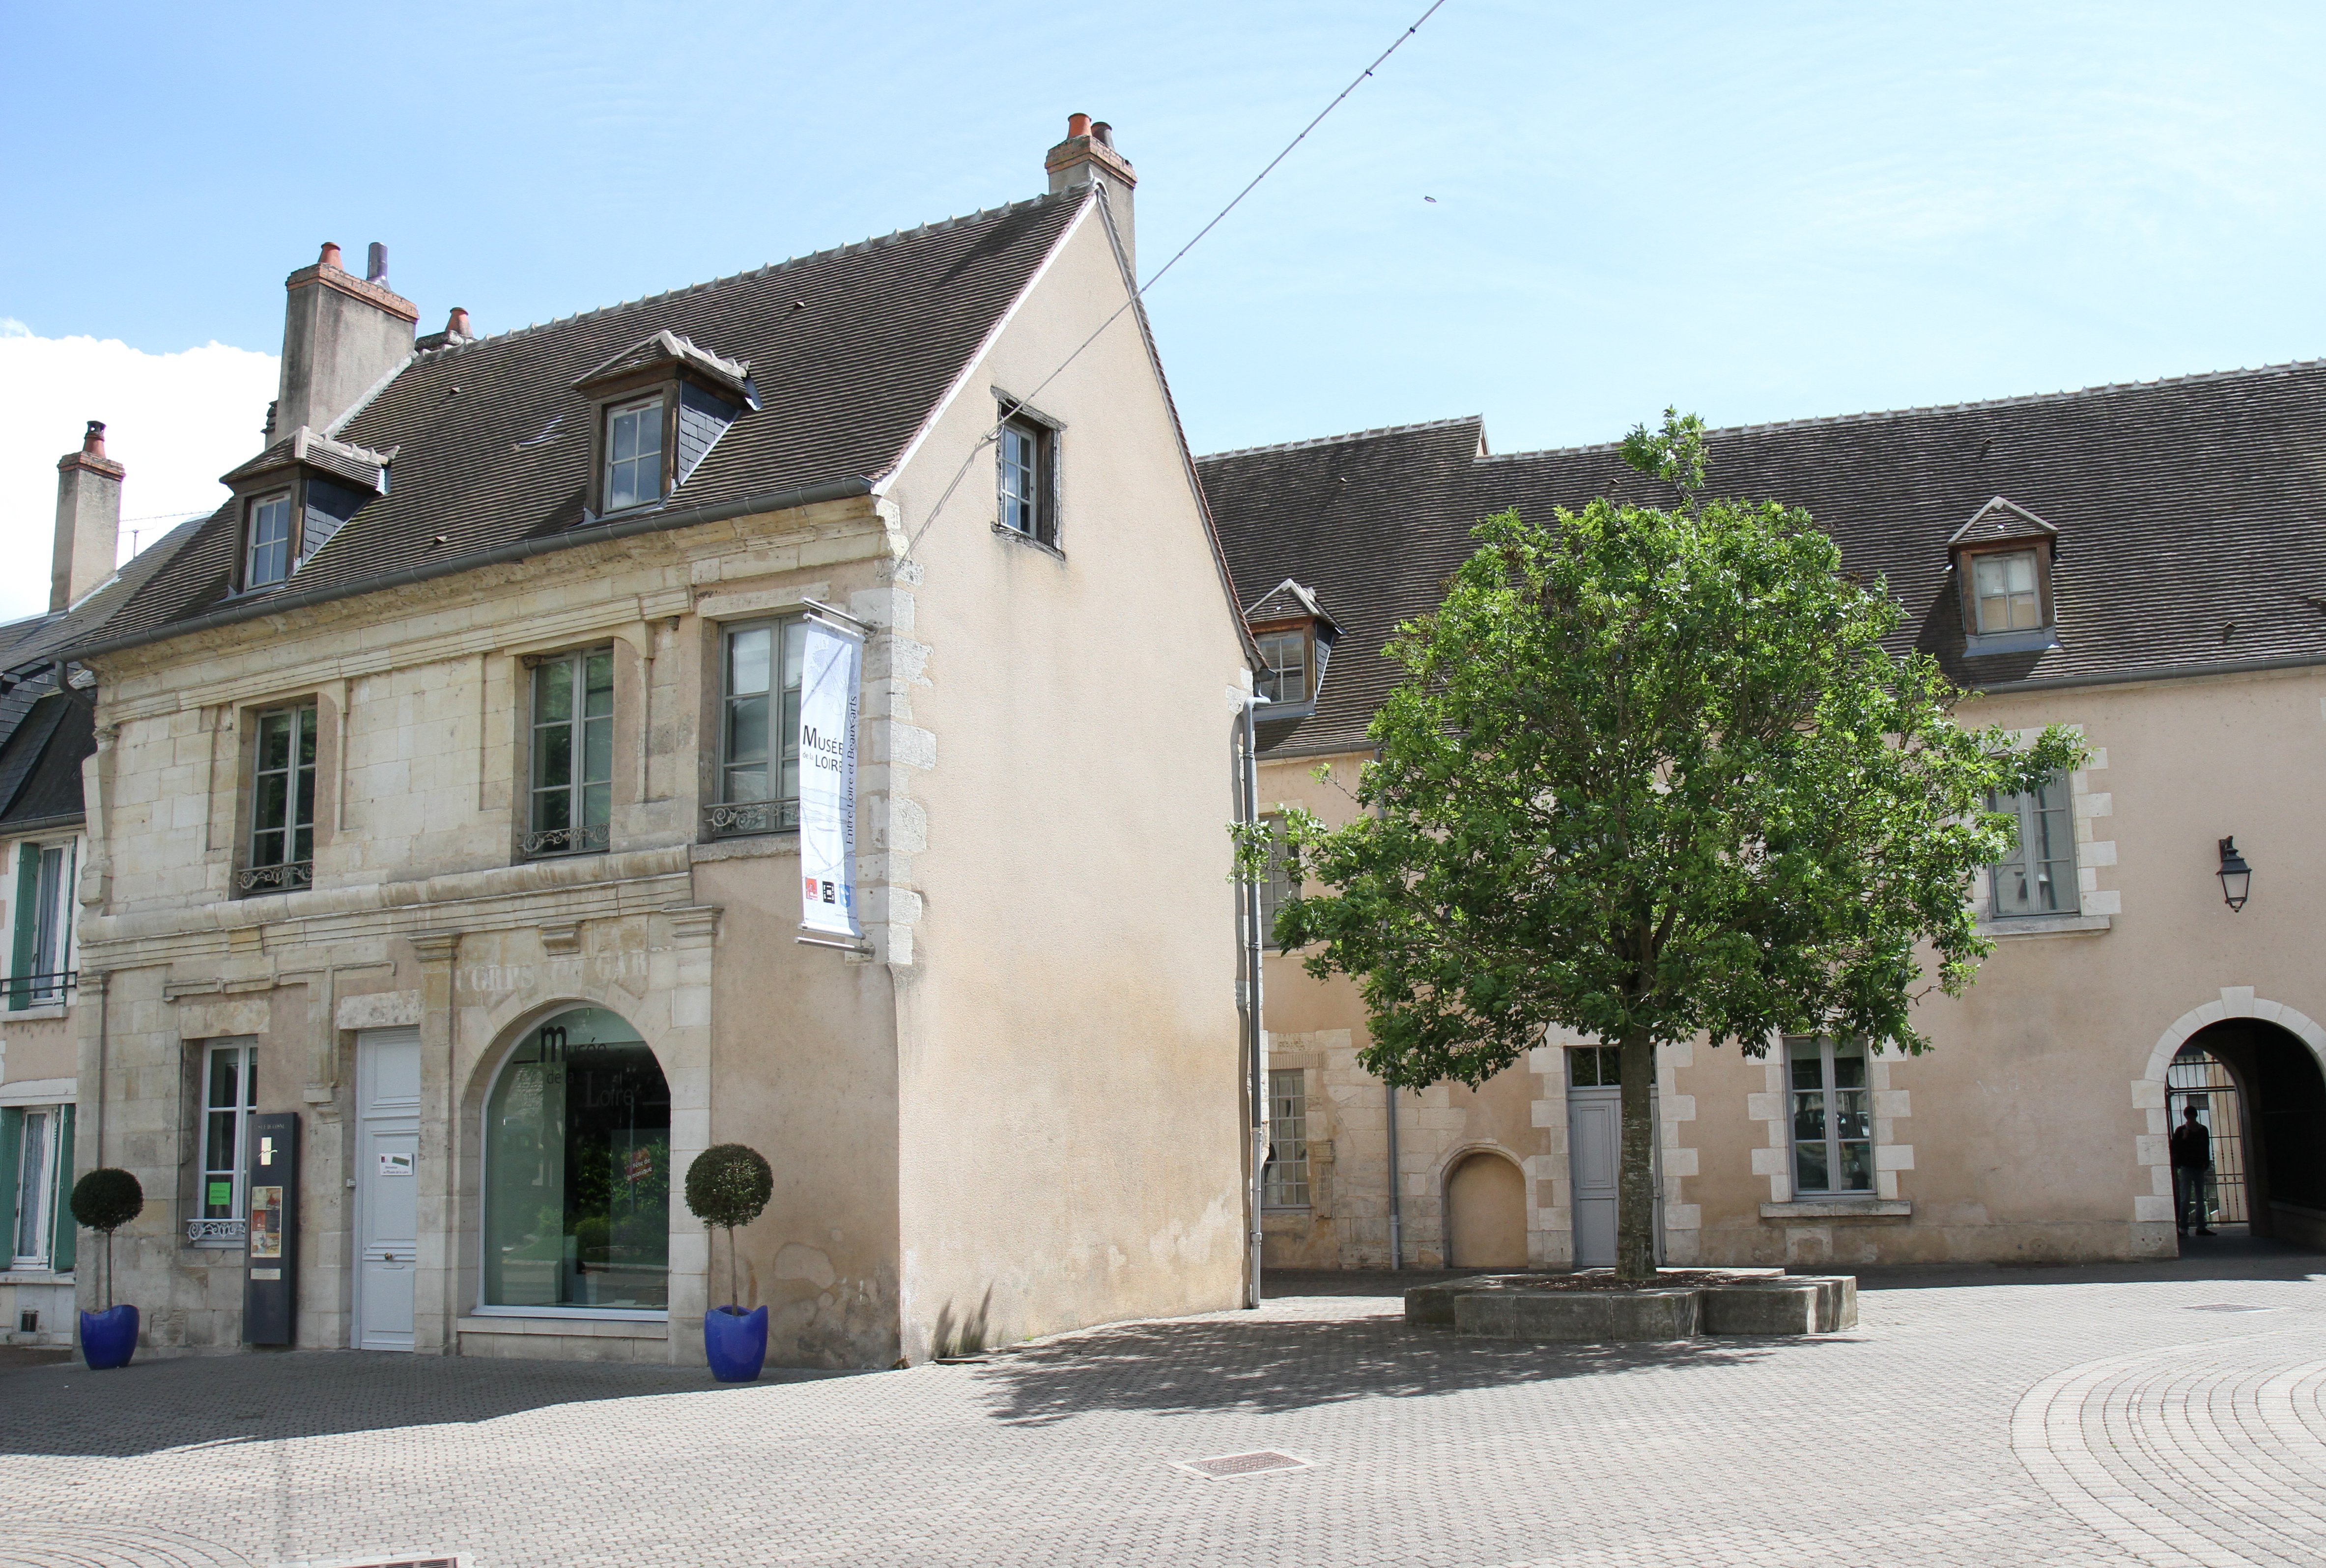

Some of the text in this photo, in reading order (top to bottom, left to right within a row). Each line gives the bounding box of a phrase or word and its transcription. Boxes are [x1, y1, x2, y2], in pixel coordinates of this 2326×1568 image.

[847, 695, 857, 759] Beaux-arts
[848, 763, 854, 774] et
[547, 1069, 561, 1085] de
[585, 1071, 634, 1107] Loire
[632, 1167, 652, 1178] musique
